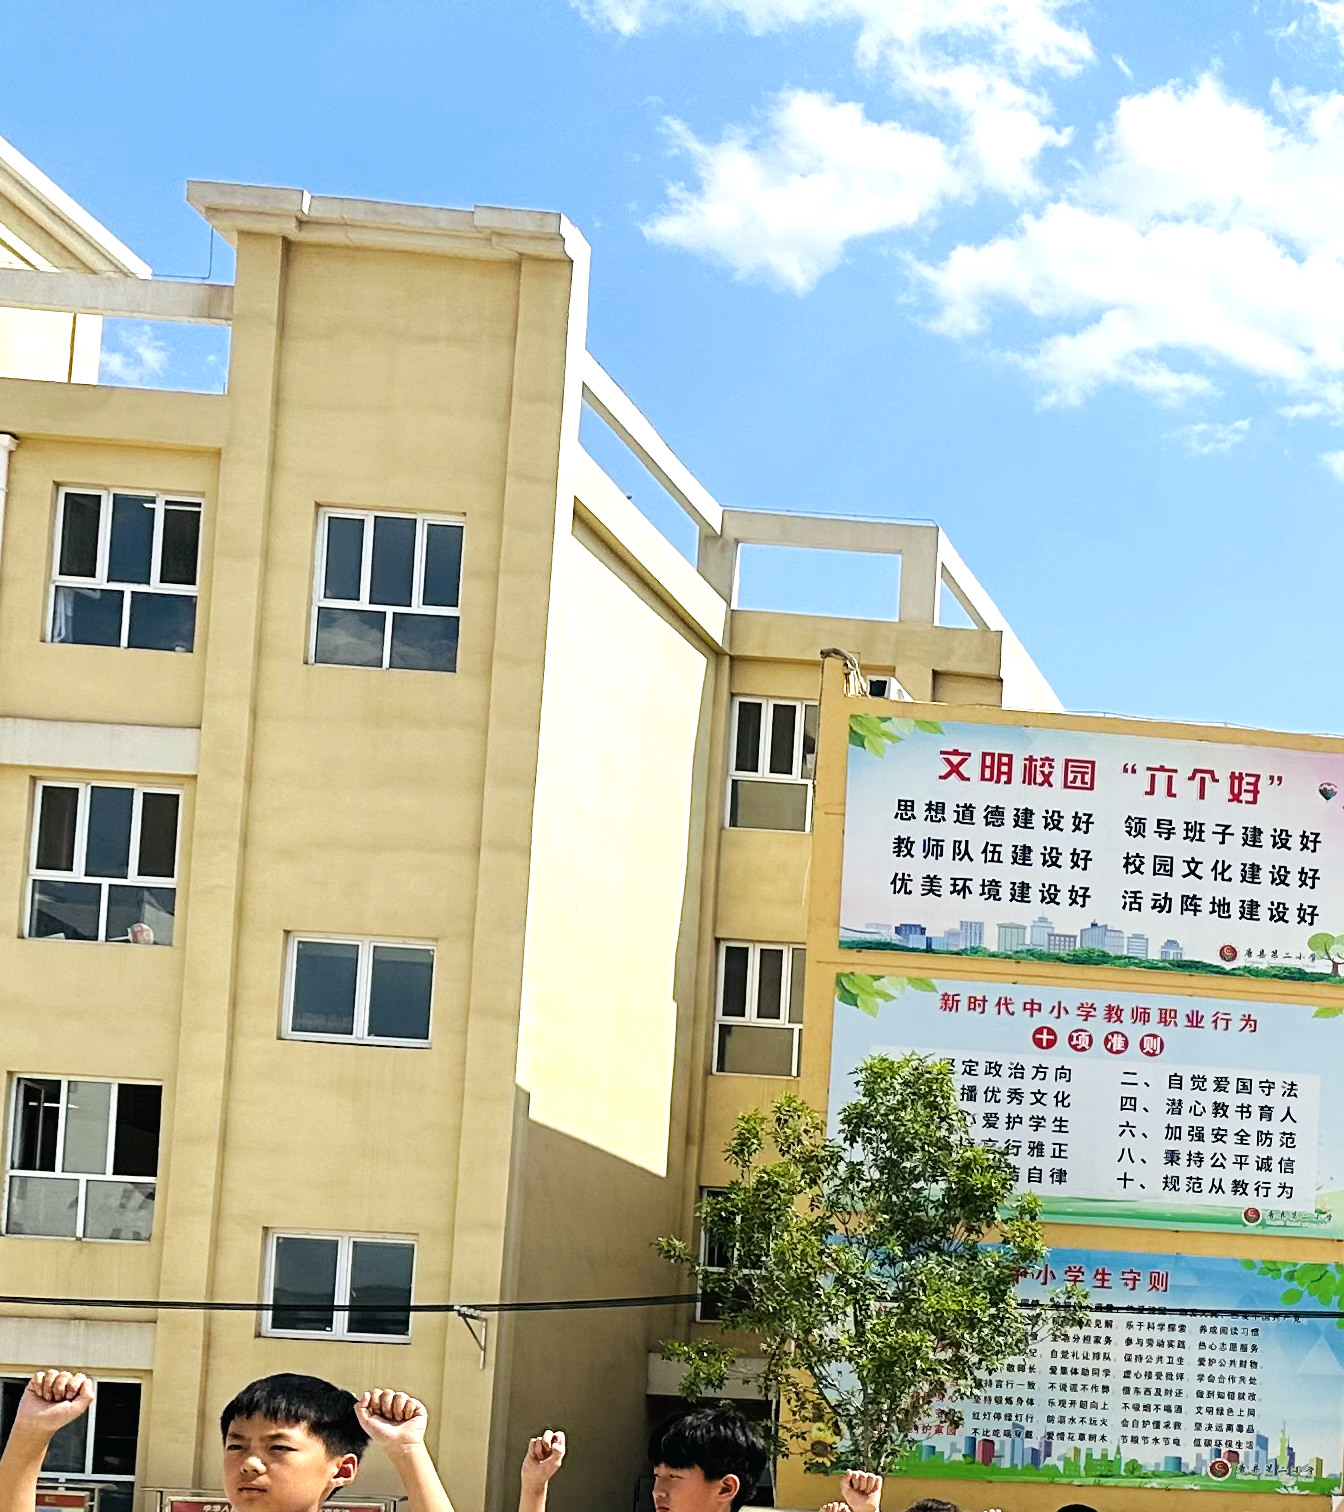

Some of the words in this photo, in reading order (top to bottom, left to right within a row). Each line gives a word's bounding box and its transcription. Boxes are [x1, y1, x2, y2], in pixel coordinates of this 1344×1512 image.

[938, 748, 1097, 791] 文明校园
[893, 798, 1096, 836] 思想道德建设好
[1123, 814, 1323, 853] 领导班子建设好
[892, 834, 1094, 871] 教师队伍建设好
[1122, 852, 1321, 890] 校园文化建设好
[890, 871, 1092, 909] 优美环境建设好
[1121, 889, 1320, 927] 活动阵地建设好
[939, 991, 1260, 1034] 新时代中小学教师职业行为
[1034, 1027, 1163, 1056] 十项准则
